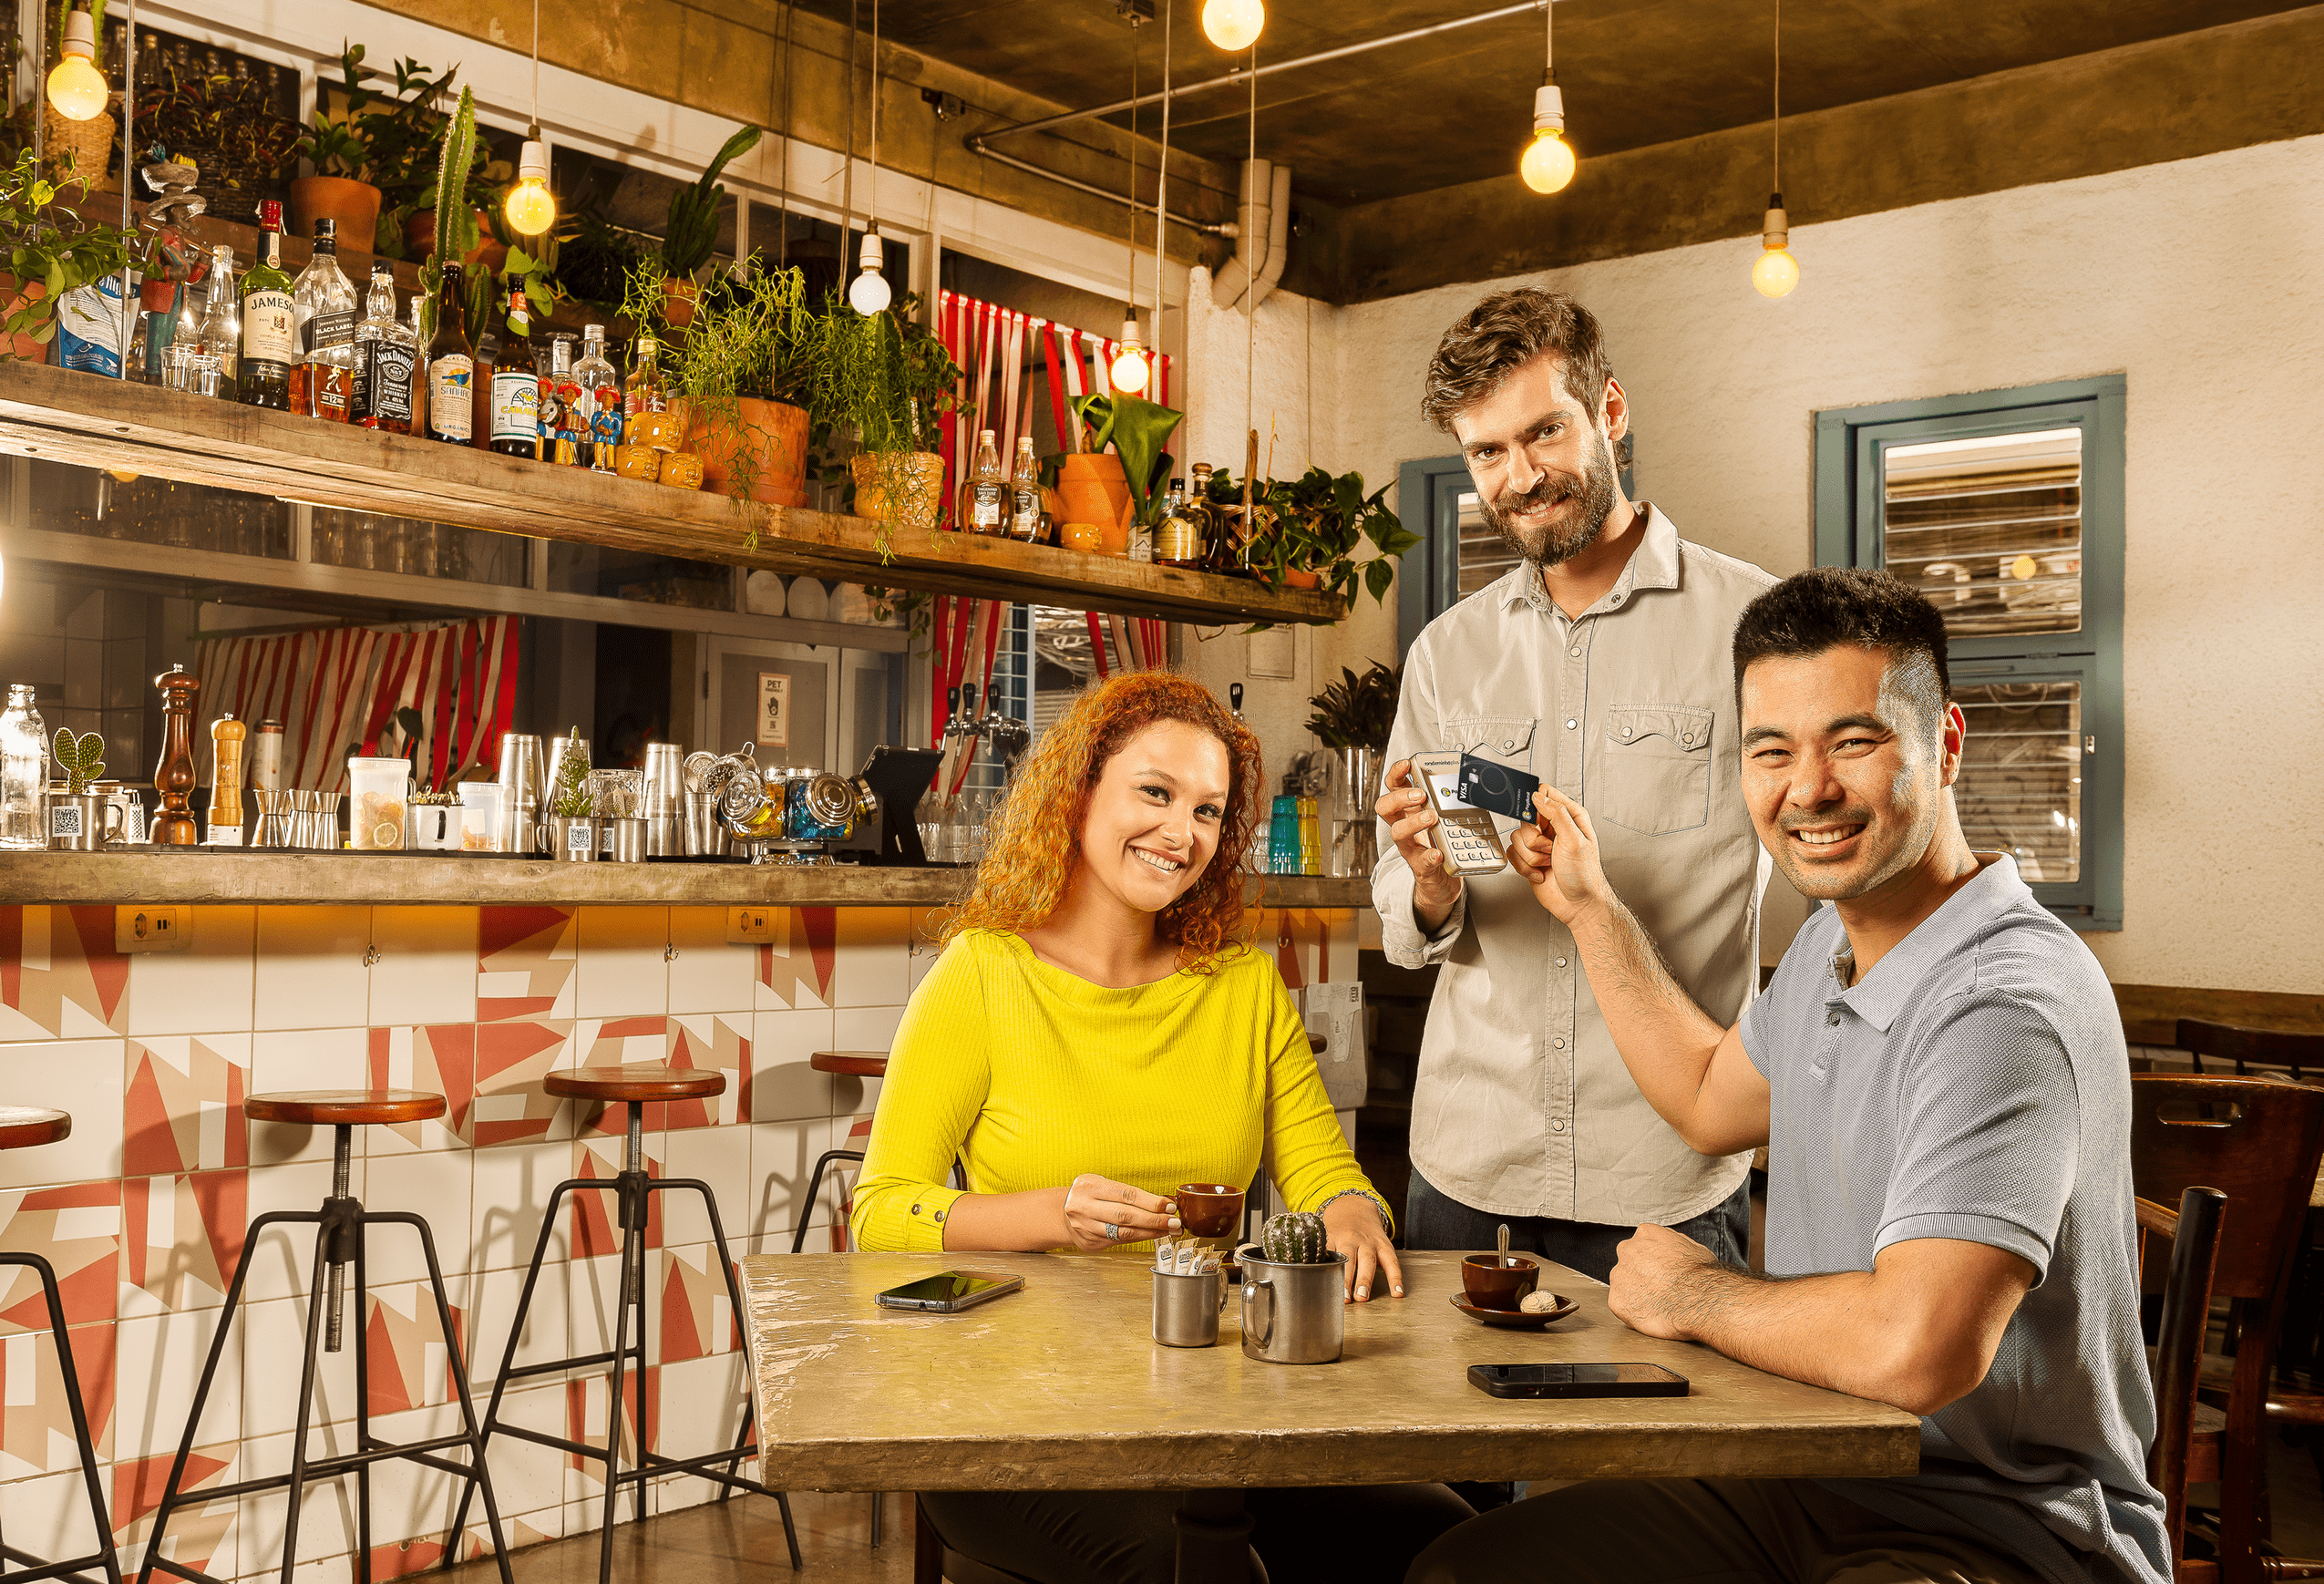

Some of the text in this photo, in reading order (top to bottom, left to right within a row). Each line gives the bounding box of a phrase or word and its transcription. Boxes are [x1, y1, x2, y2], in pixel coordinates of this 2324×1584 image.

[315, 323, 355, 334] BLACK LABEL
[376, 351, 393, 365] JACK
[383, 388, 407, 398] WHISKEY
[329, 395, 337, 404] 12
[767, 680, 782, 688] PET
[1459, 782, 1468, 799] VISA
